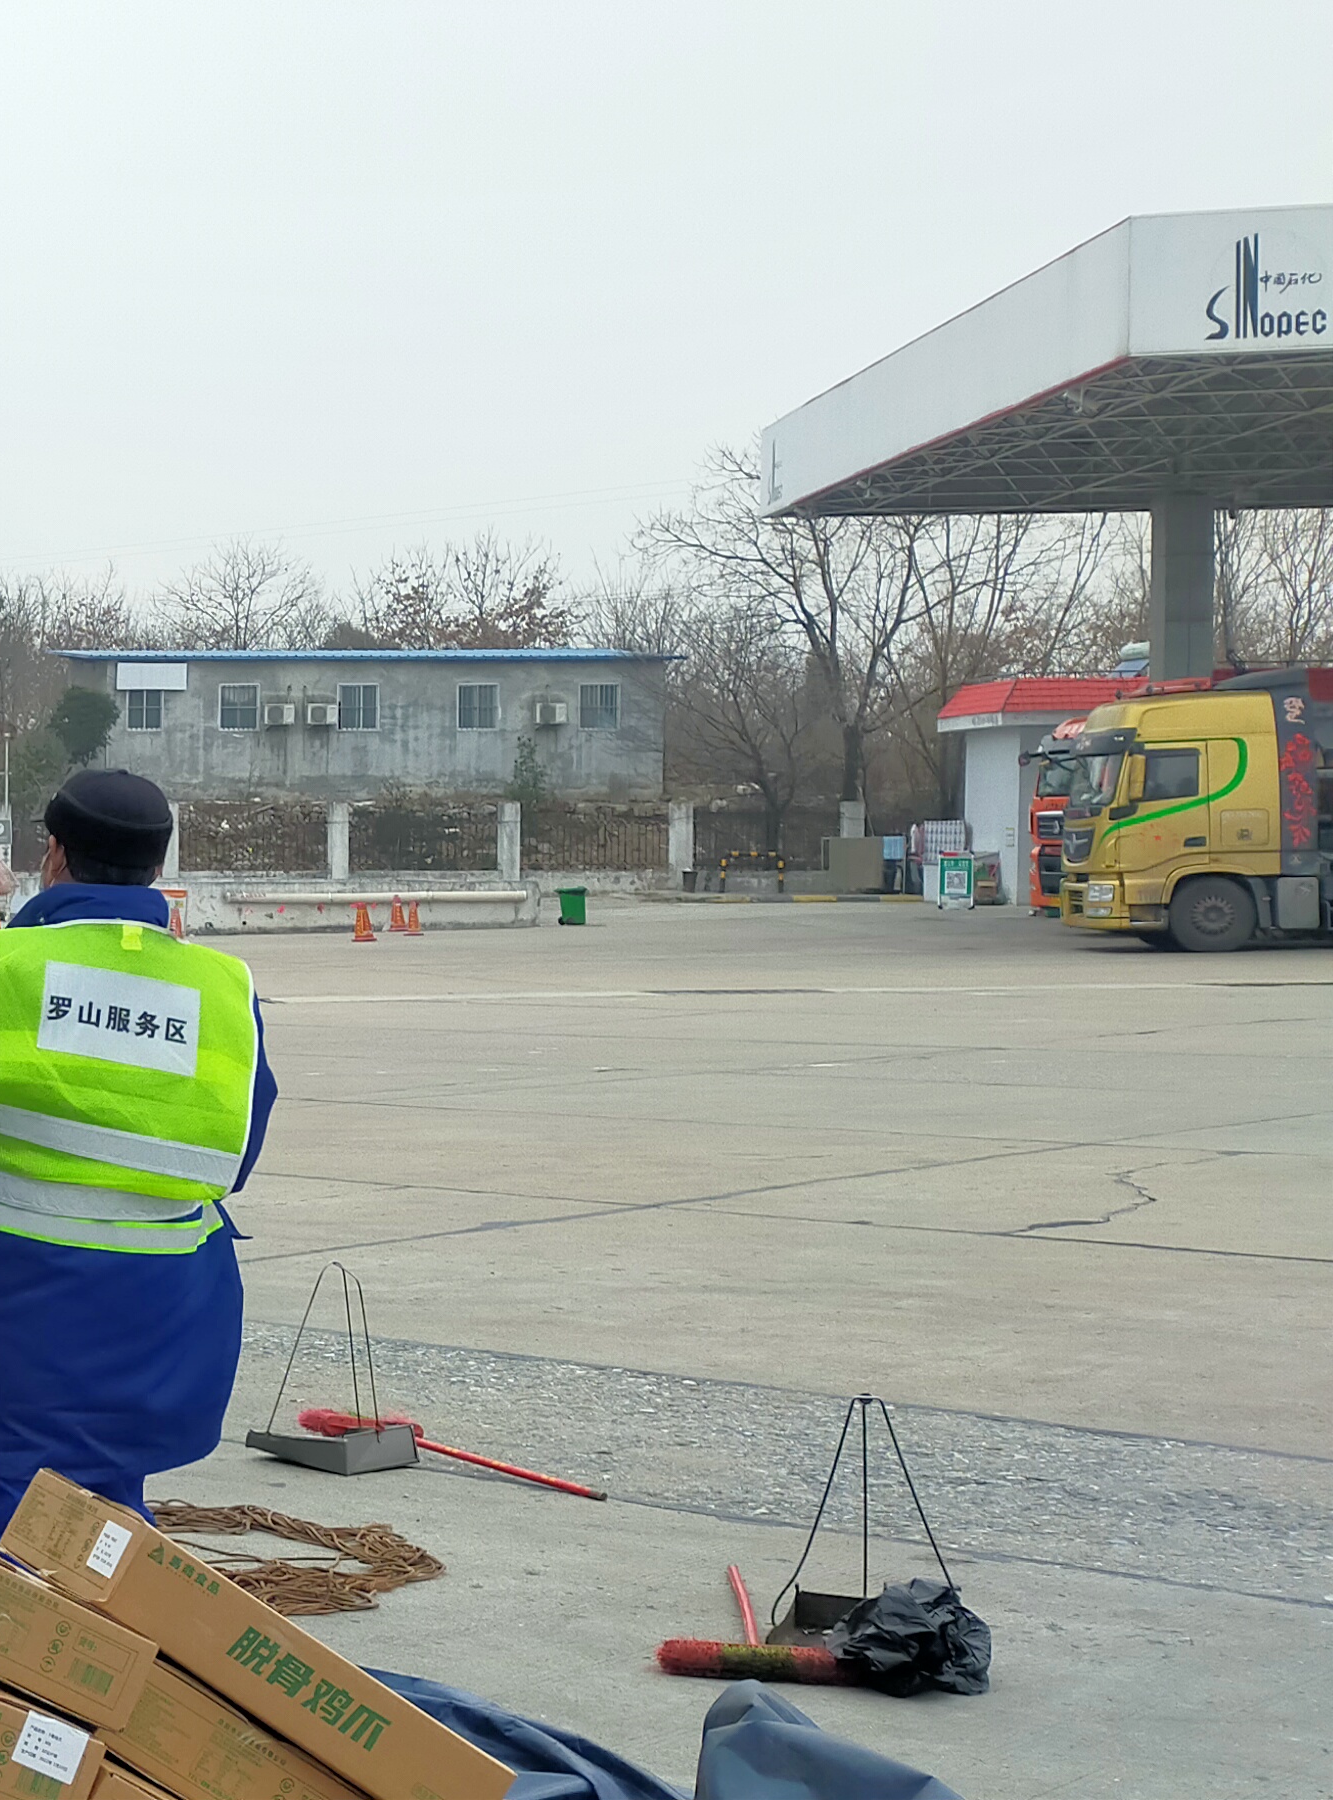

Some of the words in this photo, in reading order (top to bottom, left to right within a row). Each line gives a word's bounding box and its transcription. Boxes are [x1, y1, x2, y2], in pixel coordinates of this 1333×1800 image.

[1204, 233, 1327, 340] SINOPEC
[1258, 269, 1322, 294] 中国石化
[47, 995, 188, 1046] 罗山服务区
[225, 1625, 392, 1753] 脱骨鸡爪
